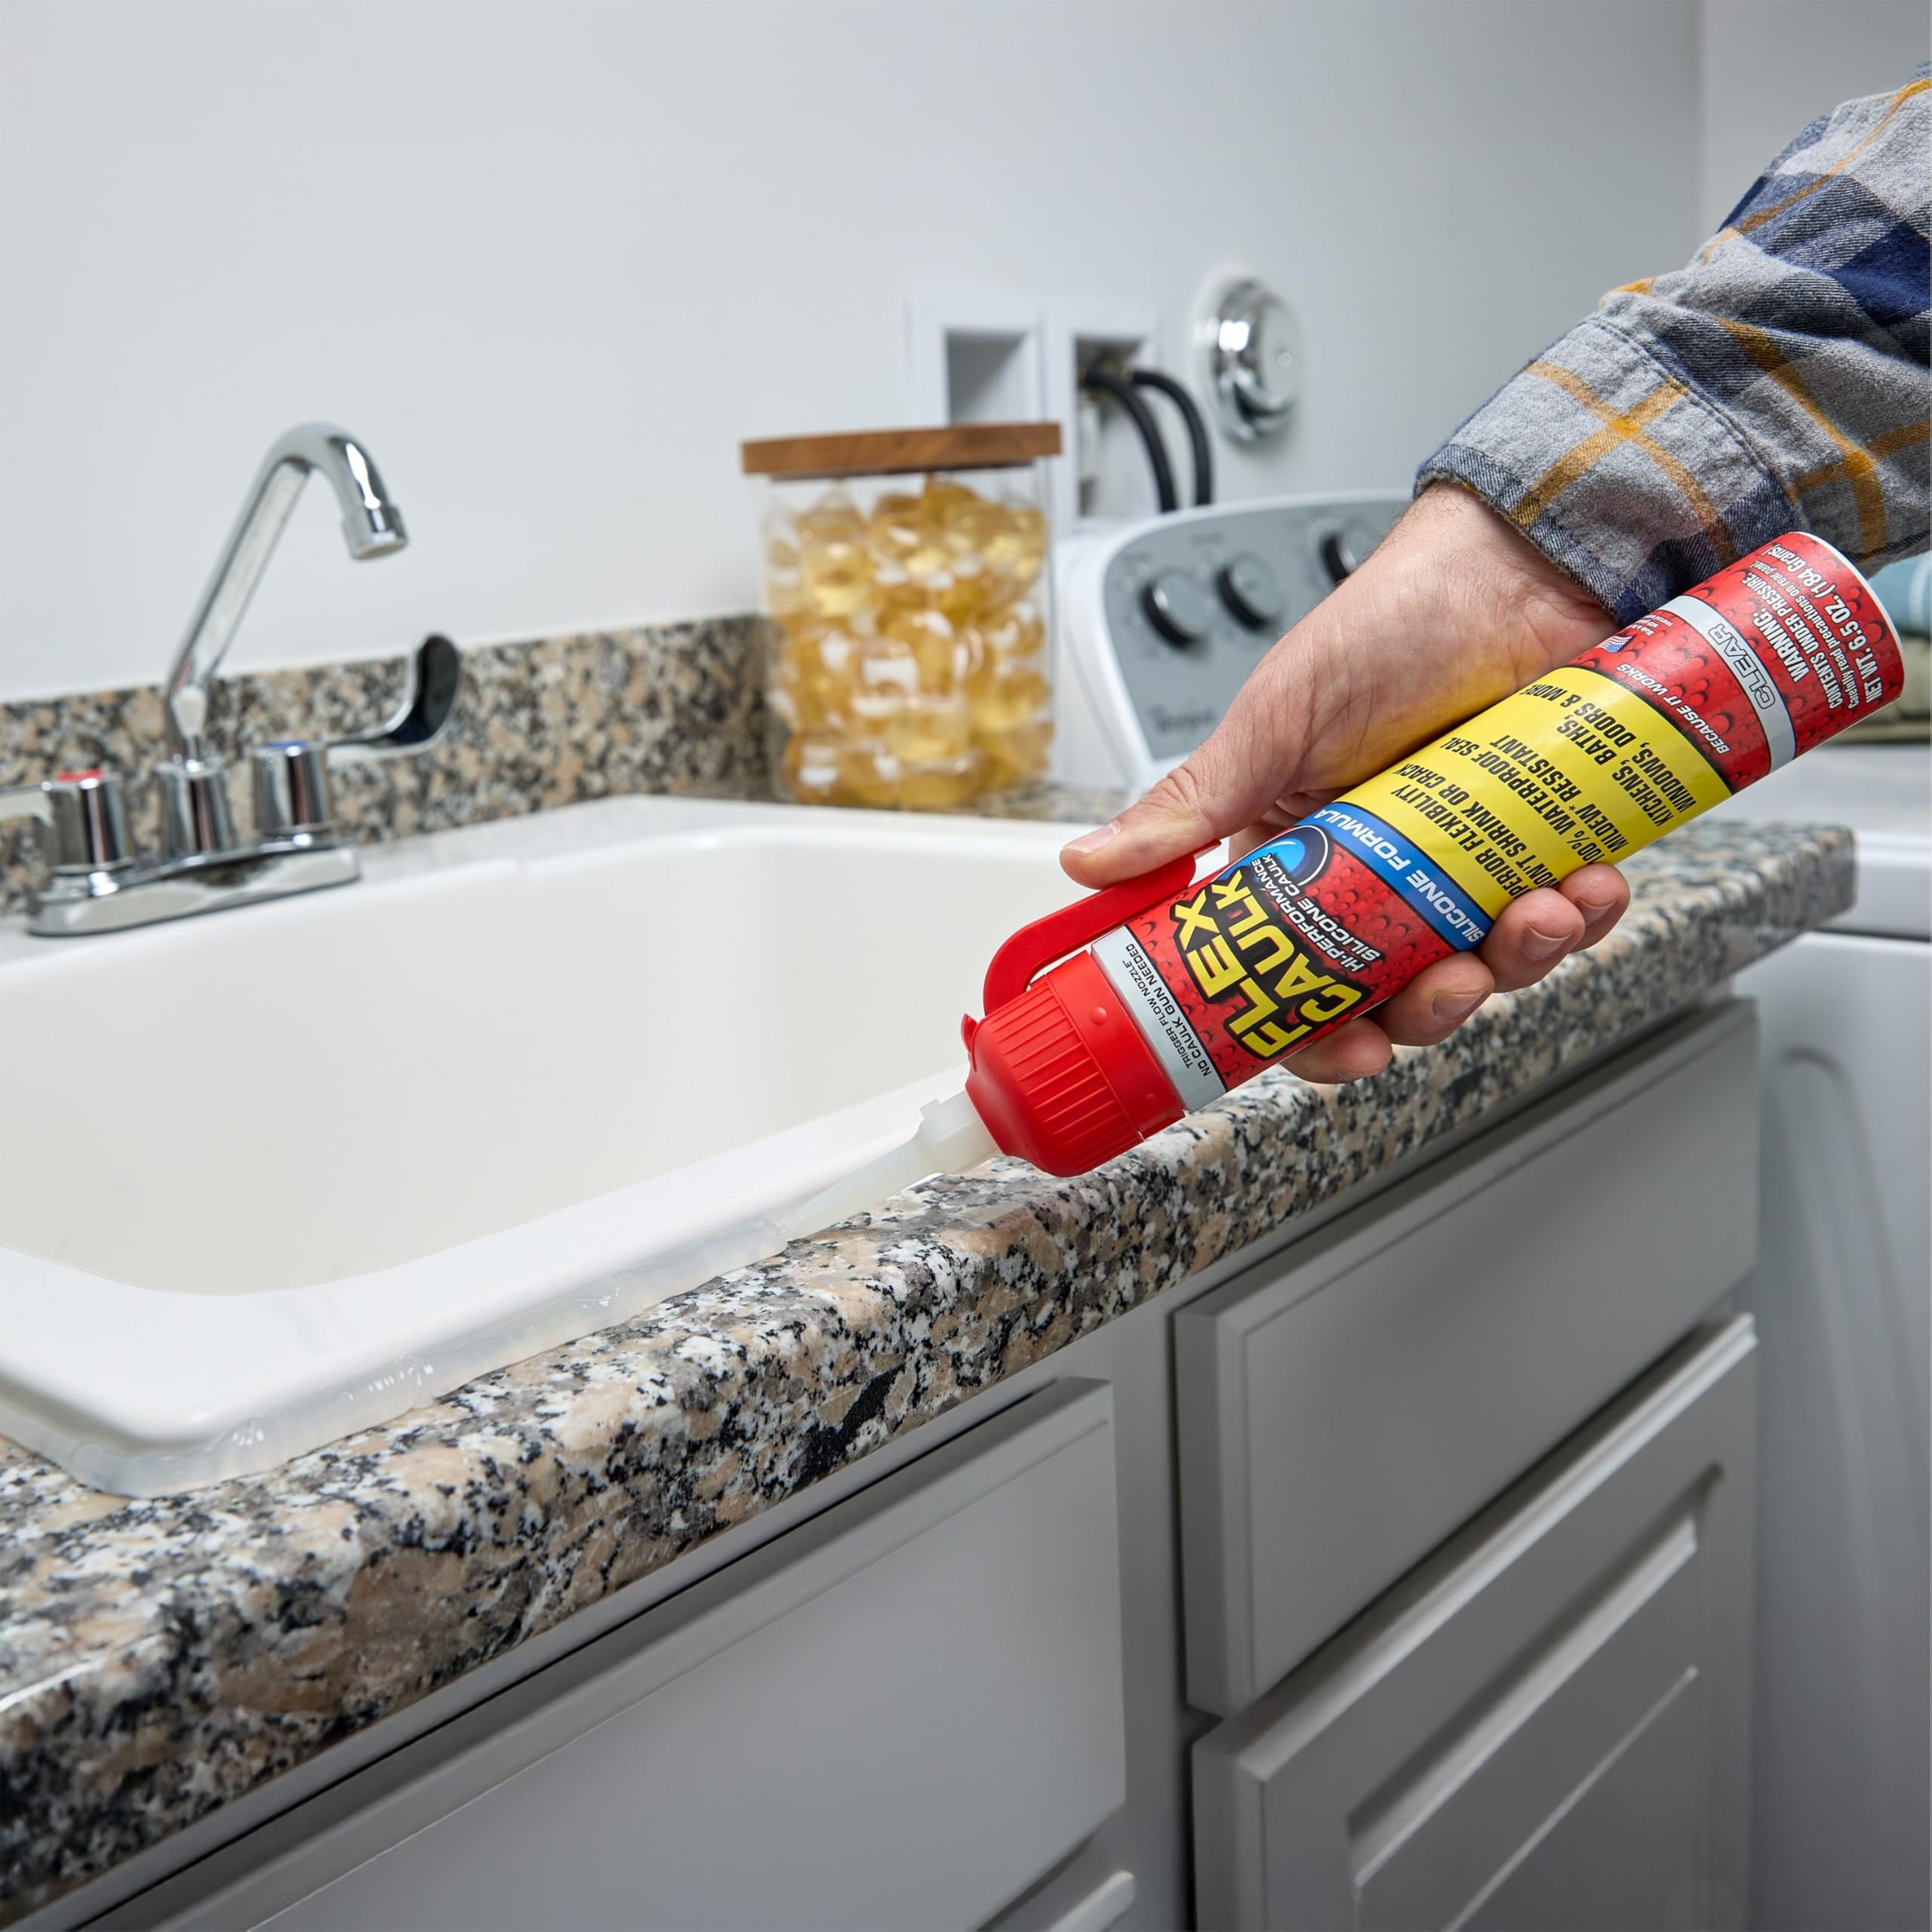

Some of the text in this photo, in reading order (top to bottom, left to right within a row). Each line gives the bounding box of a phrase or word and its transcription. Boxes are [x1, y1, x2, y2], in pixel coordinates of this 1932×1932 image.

[1707, 623, 1777, 709] CLEAR
[1741, 571, 1844, 709] CONTENTS UNDER PRESSURE.
[1749, 607, 1810, 681] WARNING:
[1750, 559, 1860, 709] Carefully read precautions on rear panel.
[1761, 544, 1882, 703] NET WT. 6.5 OZ. (184 Grams)
[1519, 685, 1697, 814] WINDOWS, DOORS & MORE
[1617, 663, 1730, 754] BECAUSE IT WORKS
[1392, 762, 1446, 789] CRACK
[1439, 737, 1605, 864] 100% WATERPROOF SEAL
[1441, 782, 1469, 804] OR
[1490, 733, 1581, 802] RESISTANT
[1556, 714, 1674, 827] KITCHENS, BATHS,
[1314, 809, 1484, 943] SILICONE FORMULA
[1390, 783, 1532, 899] PERIOR FLEXIBILITY
[1464, 801, 1527, 857] SHRINK
[1207, 869, 1362, 1026] CAULK
[1251, 857, 1364, 972] HI-PERFORMANCE
[1262, 853, 1380, 962] SILICONE CAULK
[1125, 943, 1211, 1076] NO CAULK GUN NEEDED
[1145, 995, 1168, 1026] FLOW
[1174, 889, 1312, 1060] FLEX
[1165, 1026, 1193, 1068] TRIGGER
